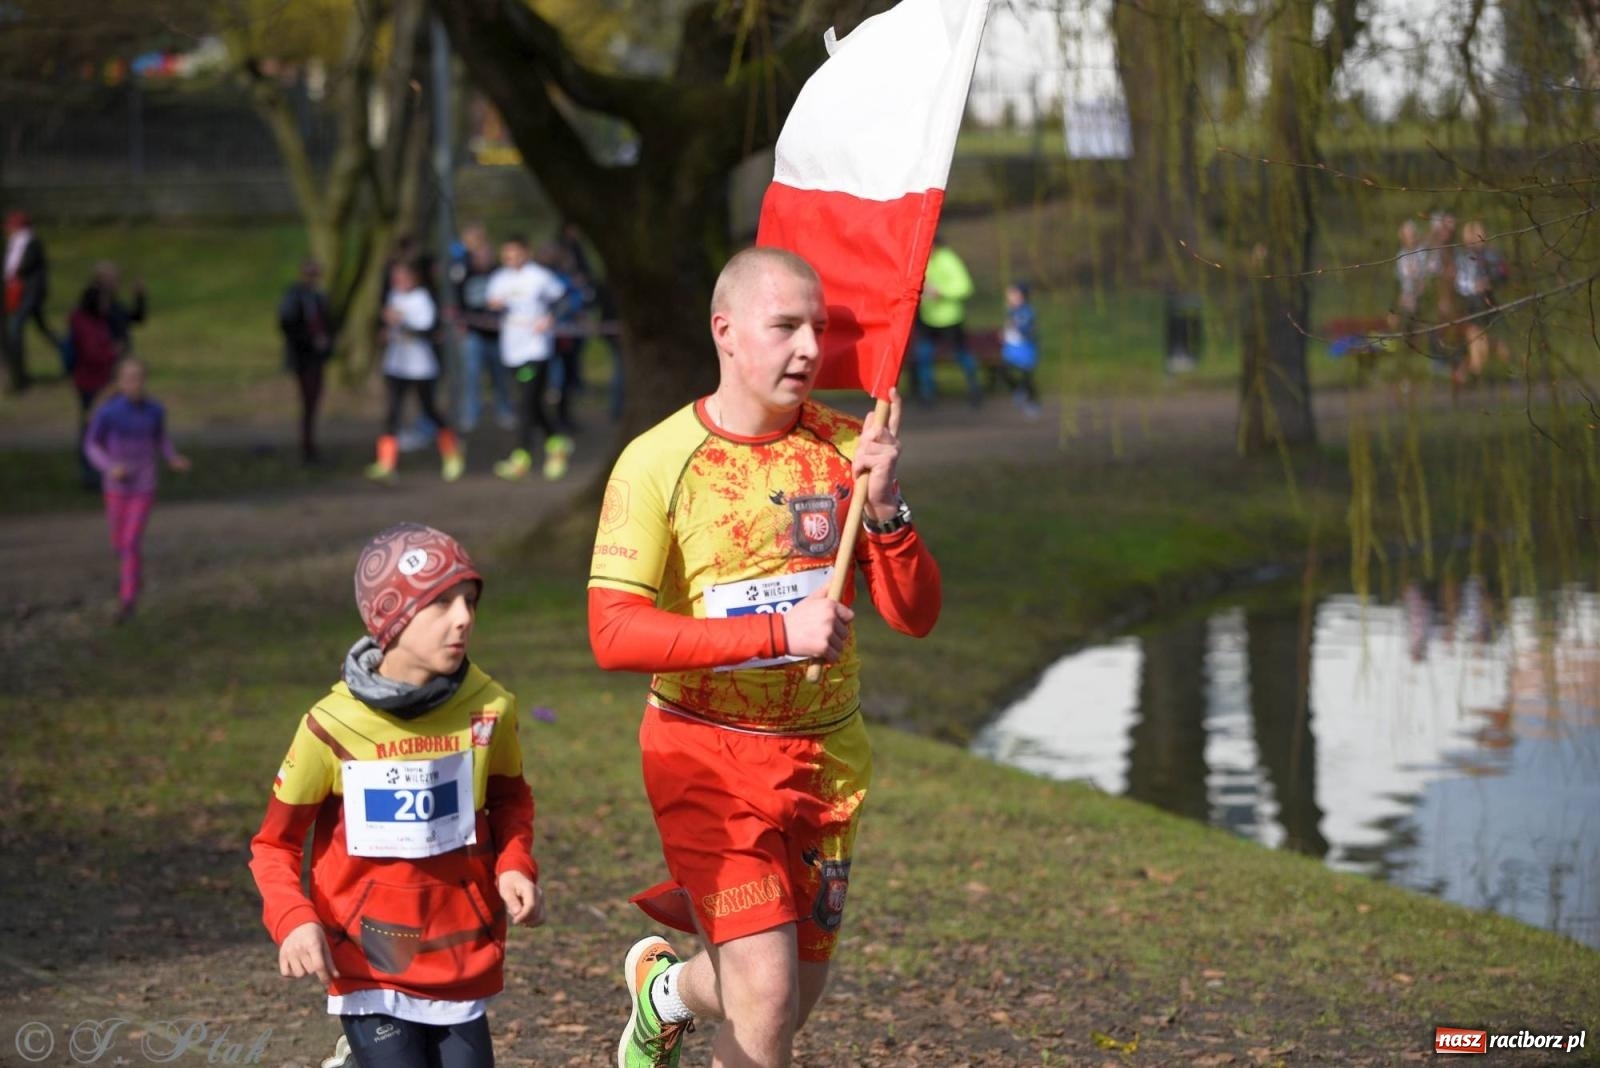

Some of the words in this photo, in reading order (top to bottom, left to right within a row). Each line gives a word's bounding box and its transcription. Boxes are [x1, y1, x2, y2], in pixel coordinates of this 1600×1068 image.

[763, 583, 799, 598] WILCZYM
[376, 735, 460, 760] RACIBORKI
[394, 789, 434, 820] 20
